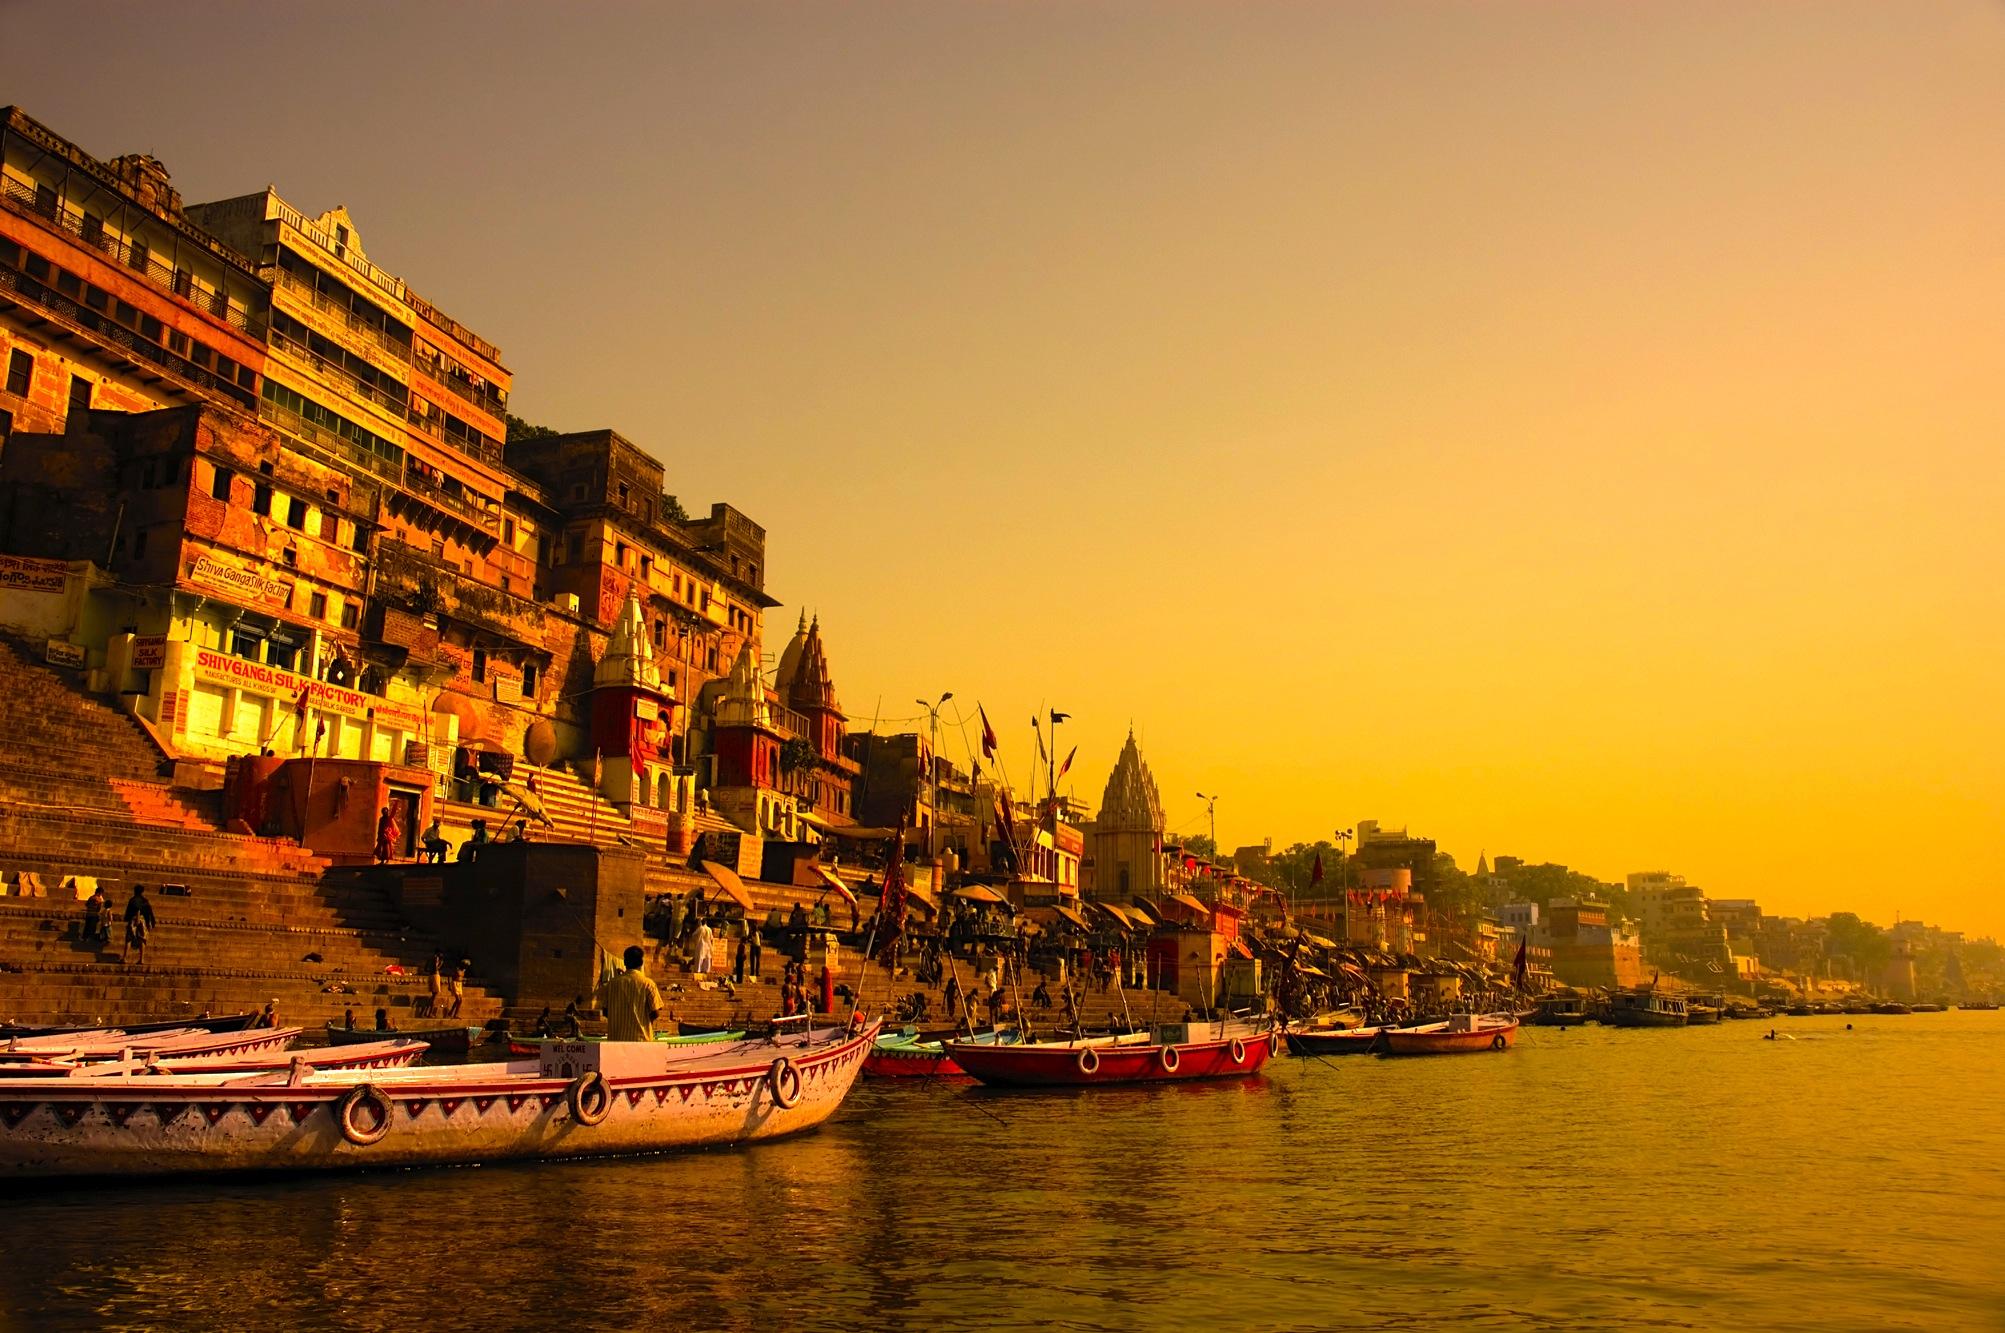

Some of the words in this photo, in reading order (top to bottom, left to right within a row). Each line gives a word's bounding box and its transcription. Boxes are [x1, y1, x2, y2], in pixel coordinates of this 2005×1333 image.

[138, 648, 158, 657] SILK
[134, 656, 163, 666] FACTORY
[198, 652, 273, 684] SHIVGANGA
[275, 673, 309, 692] SILK
[310, 682, 367, 708] FACTORY
